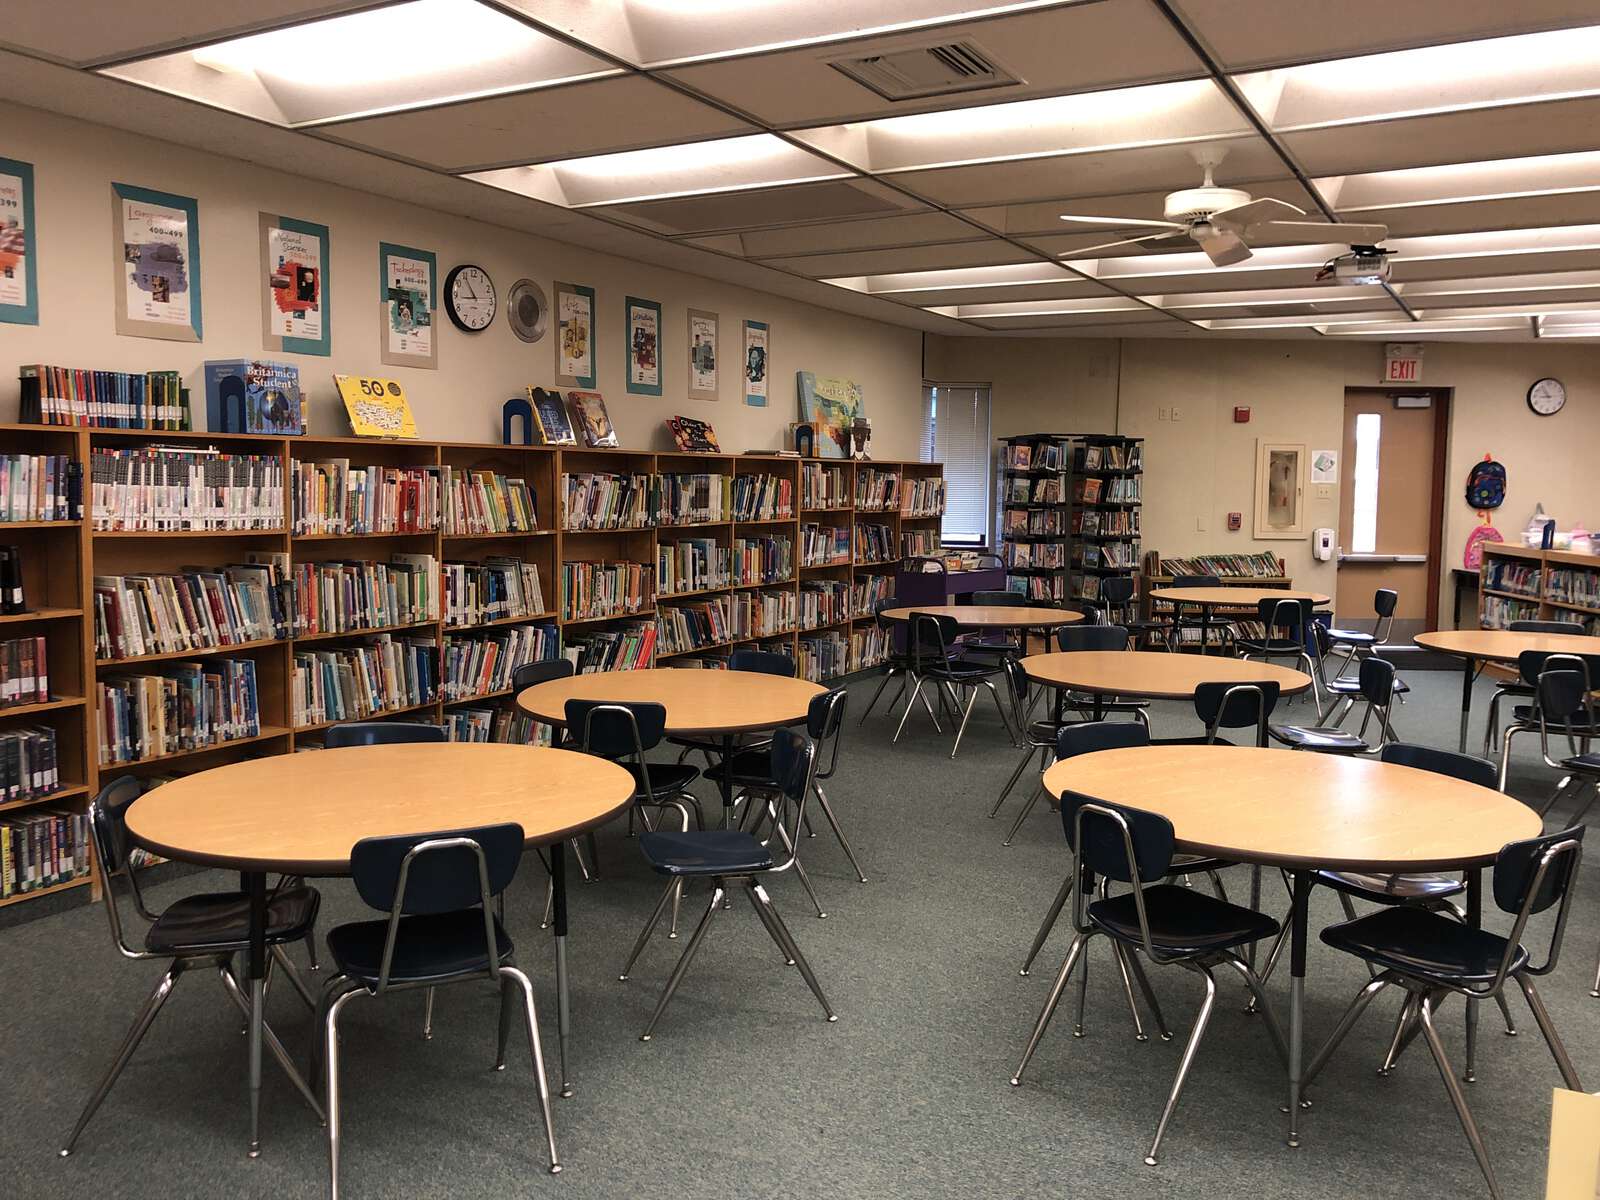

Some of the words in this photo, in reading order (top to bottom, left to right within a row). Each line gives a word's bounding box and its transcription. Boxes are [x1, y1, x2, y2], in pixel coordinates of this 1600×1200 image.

[246, 366, 297, 379] Britannica
[1391, 360, 1417, 379] EXIT
[252, 376, 292, 388] Student
[359, 379, 385, 397] 50
